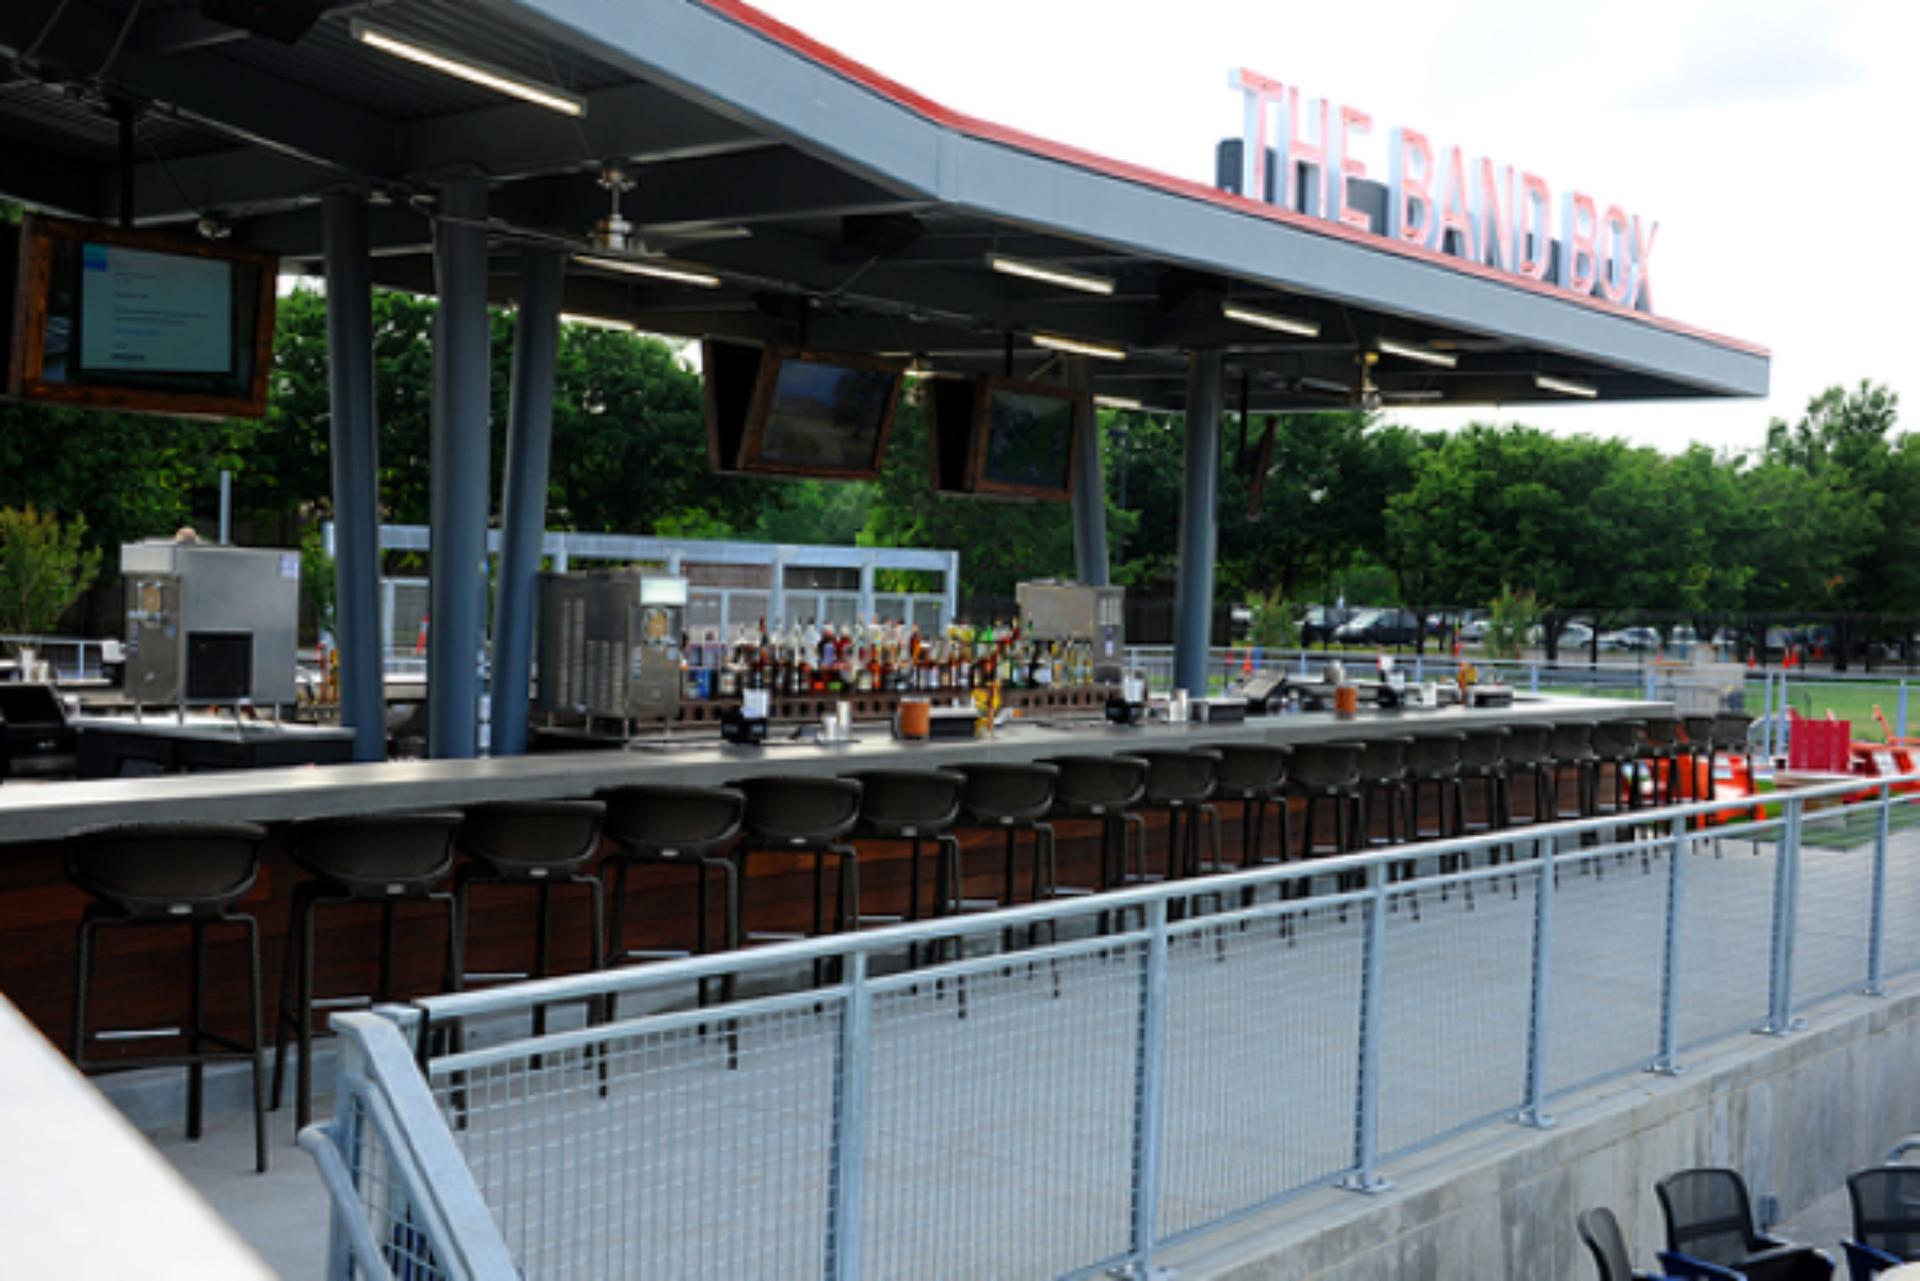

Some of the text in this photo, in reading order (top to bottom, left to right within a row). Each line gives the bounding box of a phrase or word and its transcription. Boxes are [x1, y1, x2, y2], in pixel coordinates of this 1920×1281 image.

[1230, 67, 1658, 314] THE BAND BOX
